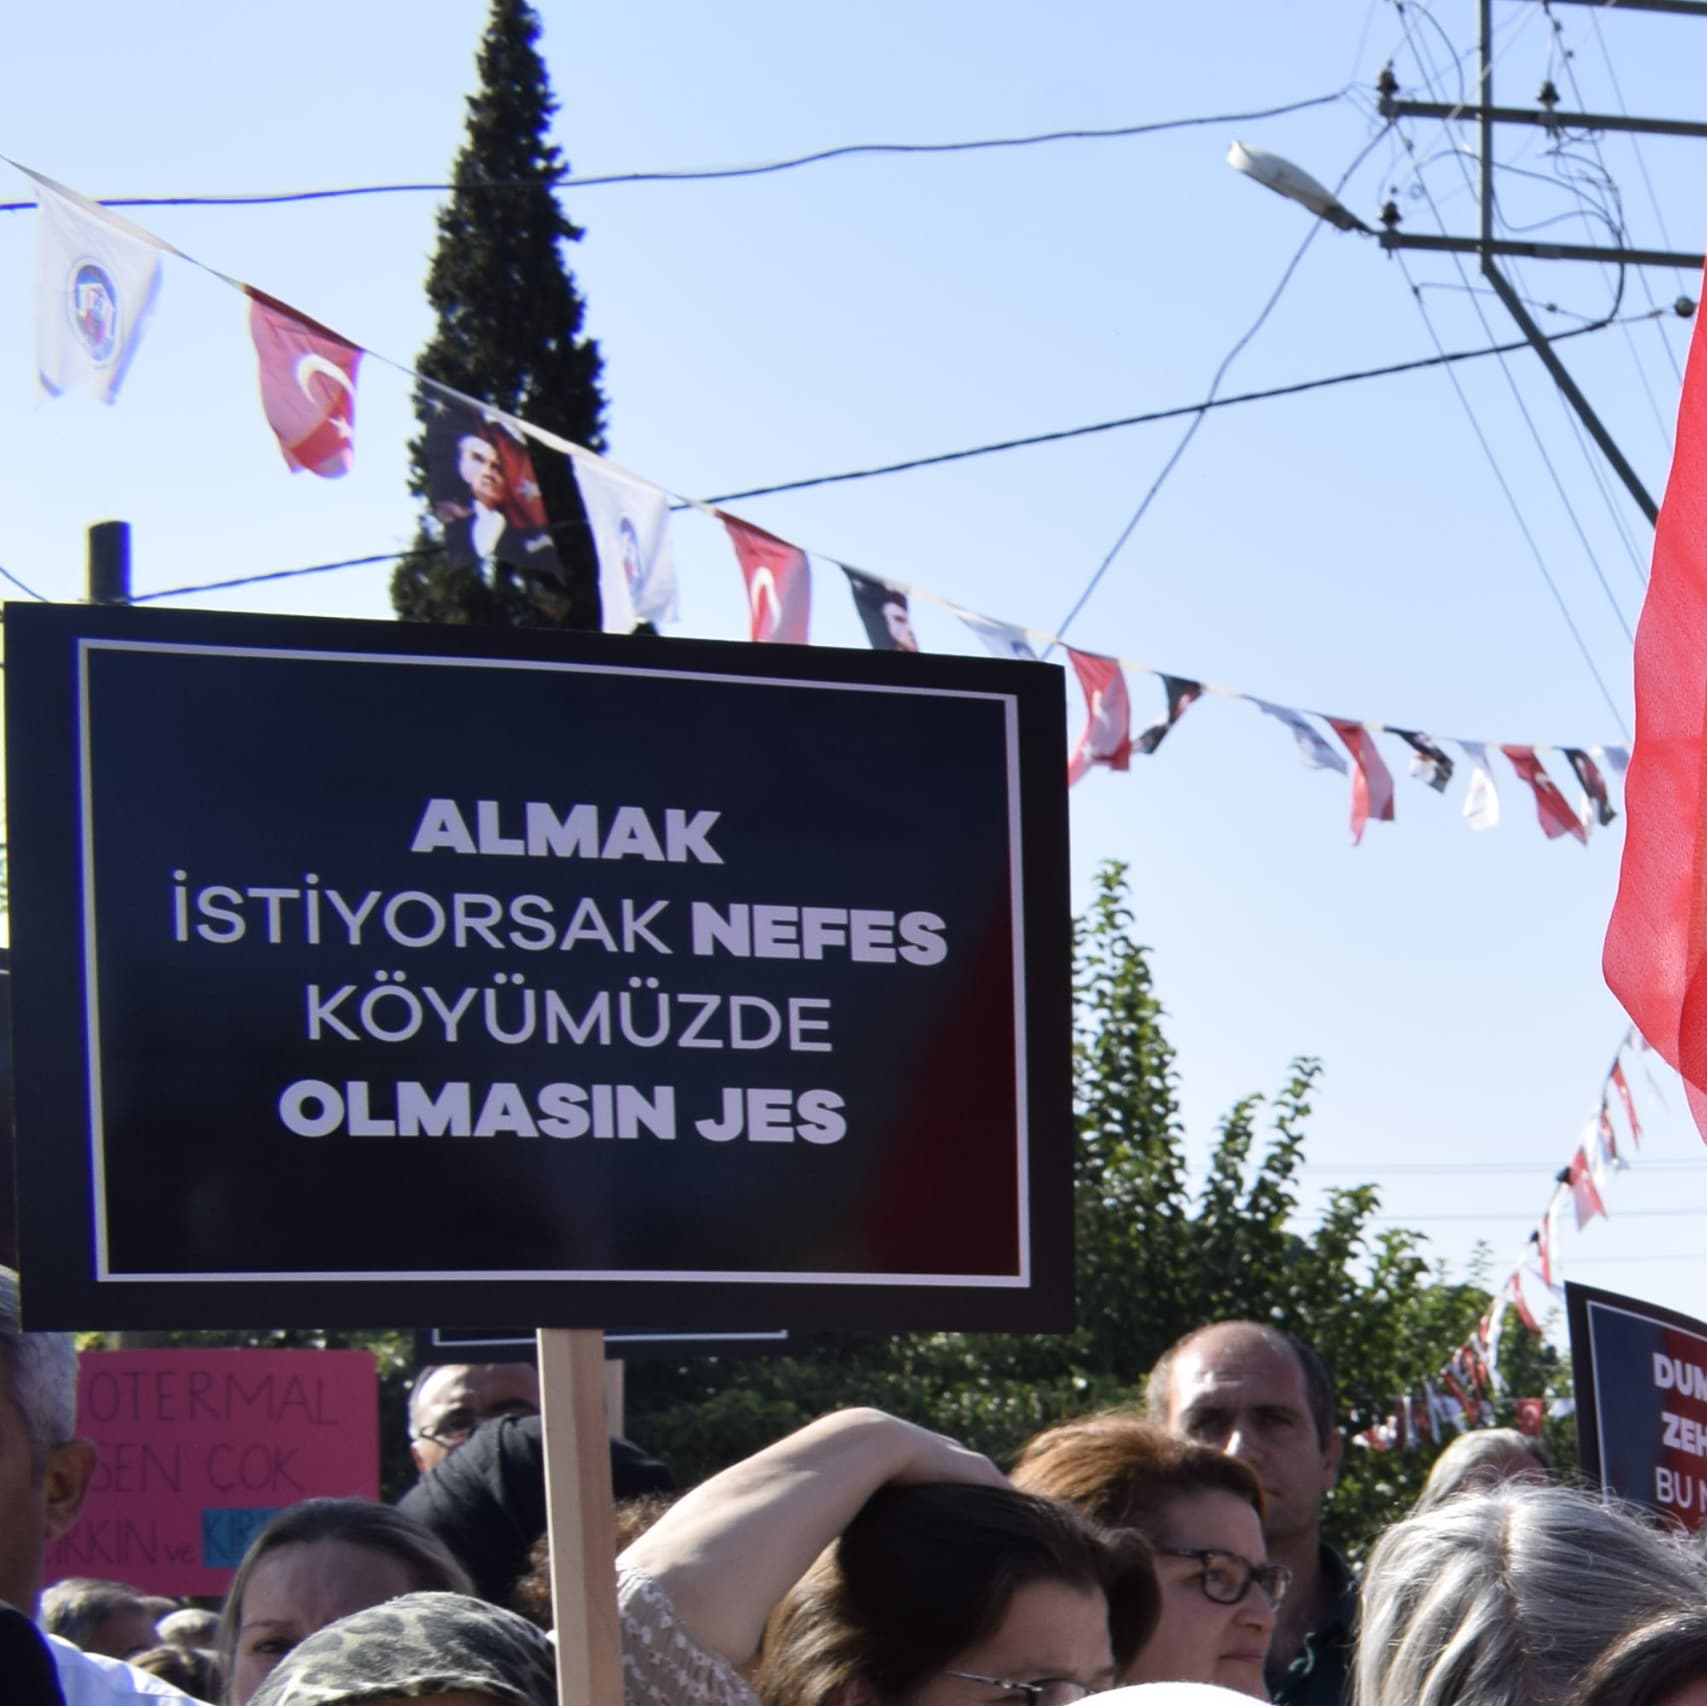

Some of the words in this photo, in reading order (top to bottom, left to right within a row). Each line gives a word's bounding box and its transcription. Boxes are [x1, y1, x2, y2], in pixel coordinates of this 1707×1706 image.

[411, 798, 725, 865] ALMAK
[172, 868, 673, 956] İSTİYORSAK
[690, 900, 948, 967] NEFES
[306, 969, 834, 1053] KÖYÜMÜZDE
[278, 1078, 677, 1141] OLMASIN
[694, 1085, 848, 1146] JES
[77, 1370, 338, 1425] OTERMAL
[206, 1441, 305, 1496] ÇOK
[1655, 1466, 1693, 1508] BU
